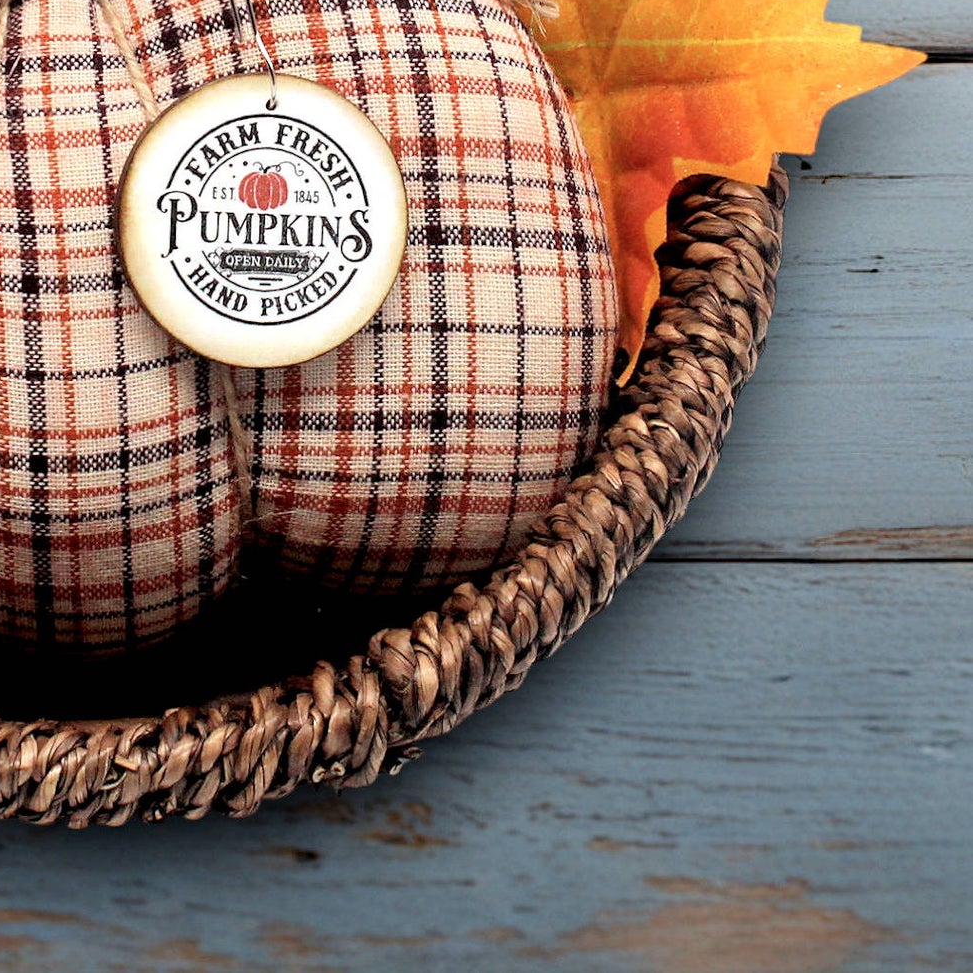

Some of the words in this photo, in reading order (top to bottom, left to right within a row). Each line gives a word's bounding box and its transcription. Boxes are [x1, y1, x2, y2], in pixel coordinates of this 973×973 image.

[185, 122, 261, 181] FARM
[276, 123, 354, 192] FRESH
[294, 190, 320, 204] 1845
[156, 190, 373, 263] PUMPKINS
[226, 255, 261, 267] OPEN
[265, 256, 305, 268] DAILY
[188, 263, 248, 313] HAND
[260, 271, 338, 317] PICKED
